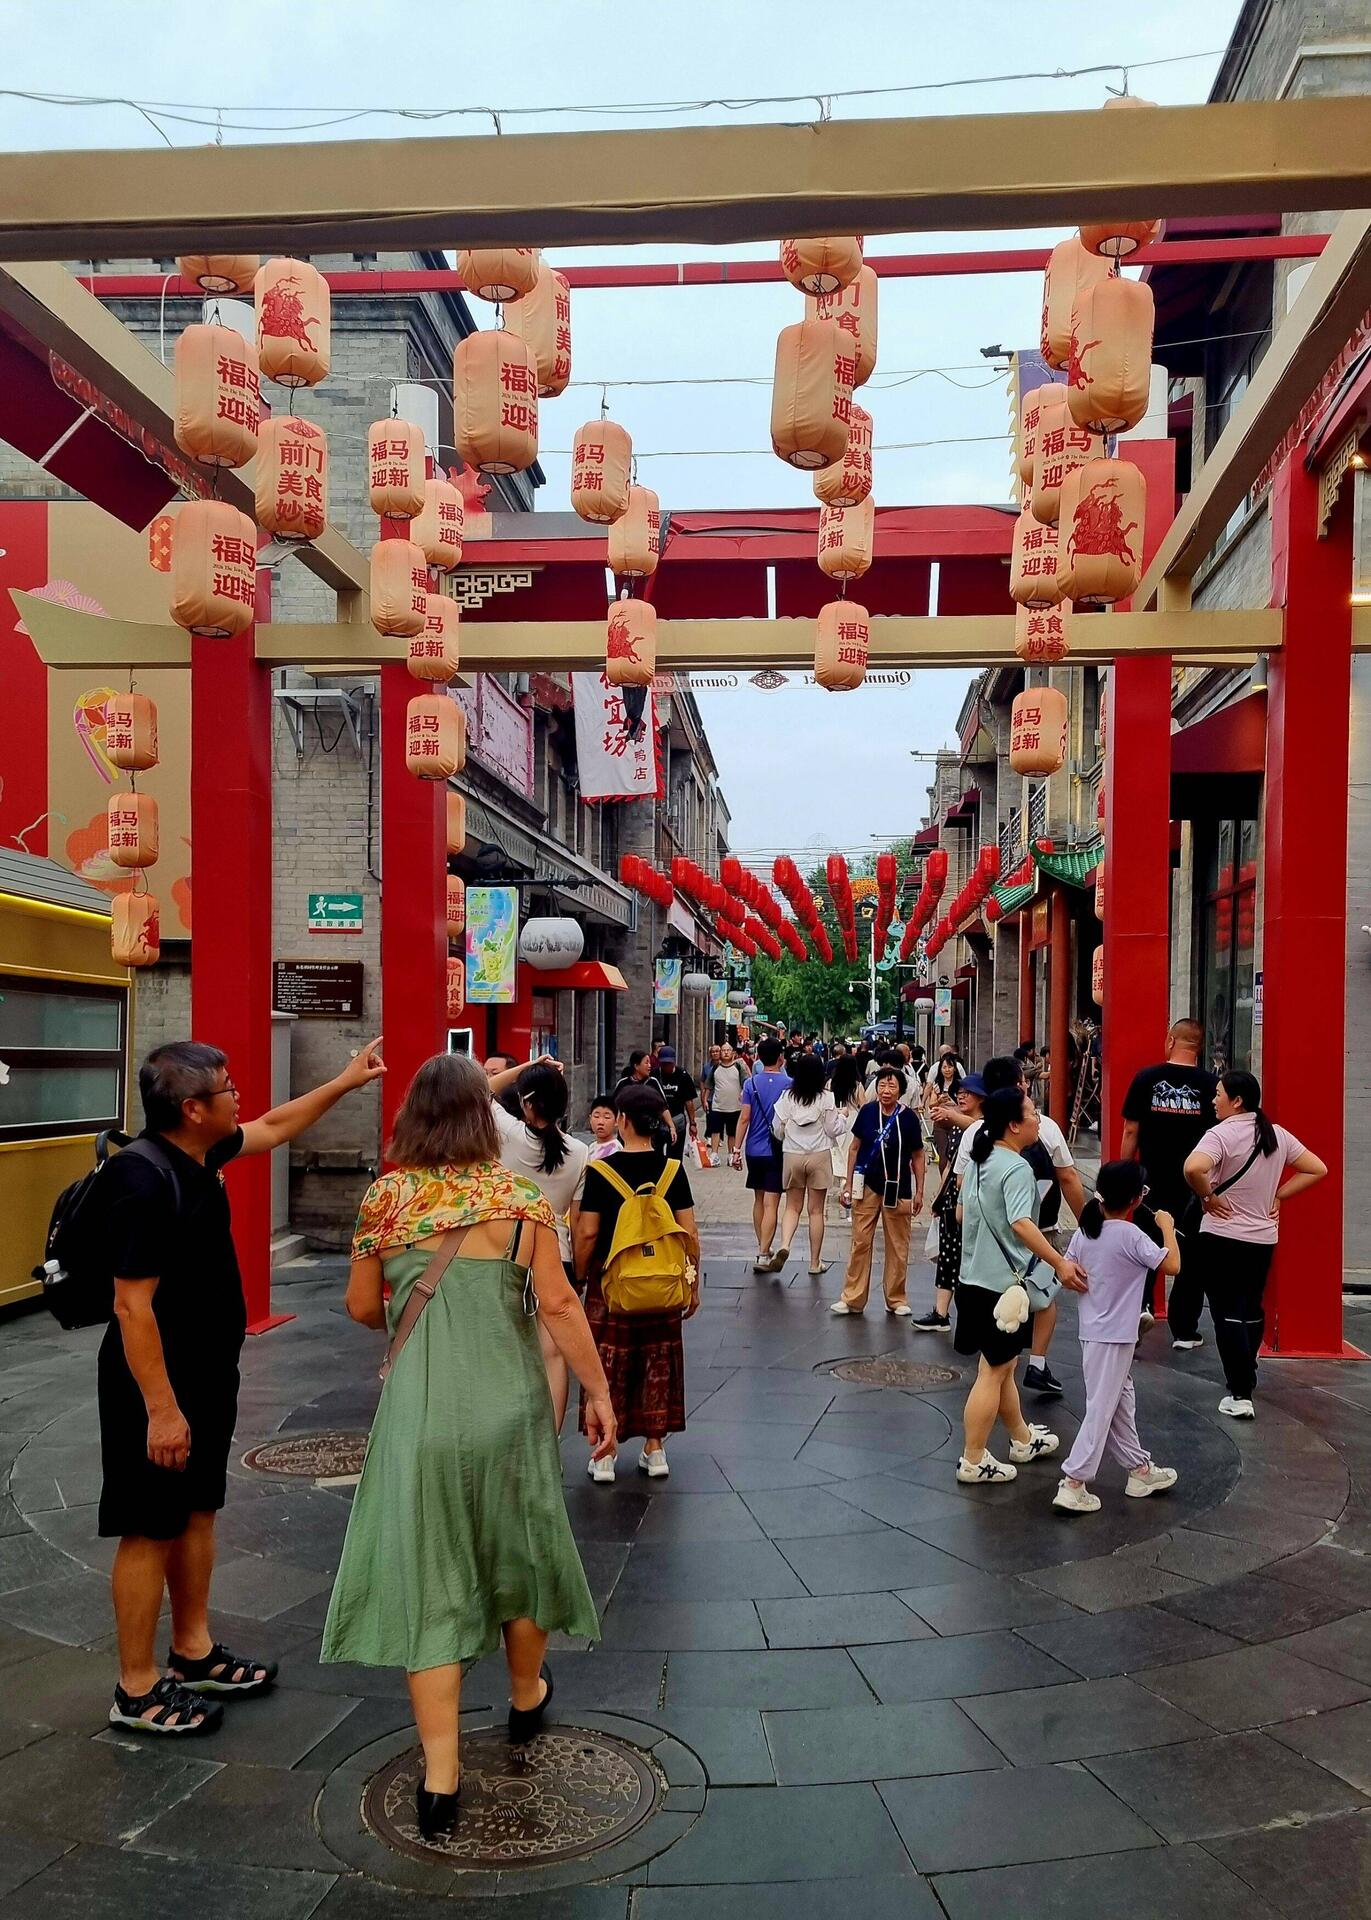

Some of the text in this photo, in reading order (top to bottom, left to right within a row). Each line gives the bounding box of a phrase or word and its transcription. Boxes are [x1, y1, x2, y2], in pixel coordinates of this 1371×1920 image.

[216, 354, 259, 400] 福马
[833, 354, 855, 385] 福
[501, 362, 537, 401] 福马
[216, 394, 259, 437] 迎新
[501, 402, 538, 440] 迎新
[1024, 406, 1040, 432] 福
[371, 440, 408, 462] 福马
[1041, 427, 1093, 458] 福马
[279, 440, 324, 473] 前门
[574, 443, 604, 465] 福马
[843, 448, 872, 474] 美食
[277, 470, 323, 503] 美食
[371, 467, 409, 488] 迎新
[573, 471, 604, 492] 迎新
[275, 499, 325, 529] 妙荟
[438, 501, 464, 527] 福马
[648, 510, 660, 529] 福
[212, 534, 256, 572] 福马
[411, 567, 426, 589] 福
[212, 572, 256, 608] 迎新
[838, 623, 869, 644] 福马
[1027, 615, 1063, 636] 美食
[409, 640, 445, 658] 迎新
[838, 648, 868, 667] 迎新
[107, 712, 133, 730] 福马
[408, 715, 439, 733] 福马
[1013, 707, 1041, 730] 福马
[107, 733, 133, 750] 迎新
[408, 740, 440, 757] 迎新
[110, 811, 138, 828] 福马
[110, 832, 138, 848] 迎新
